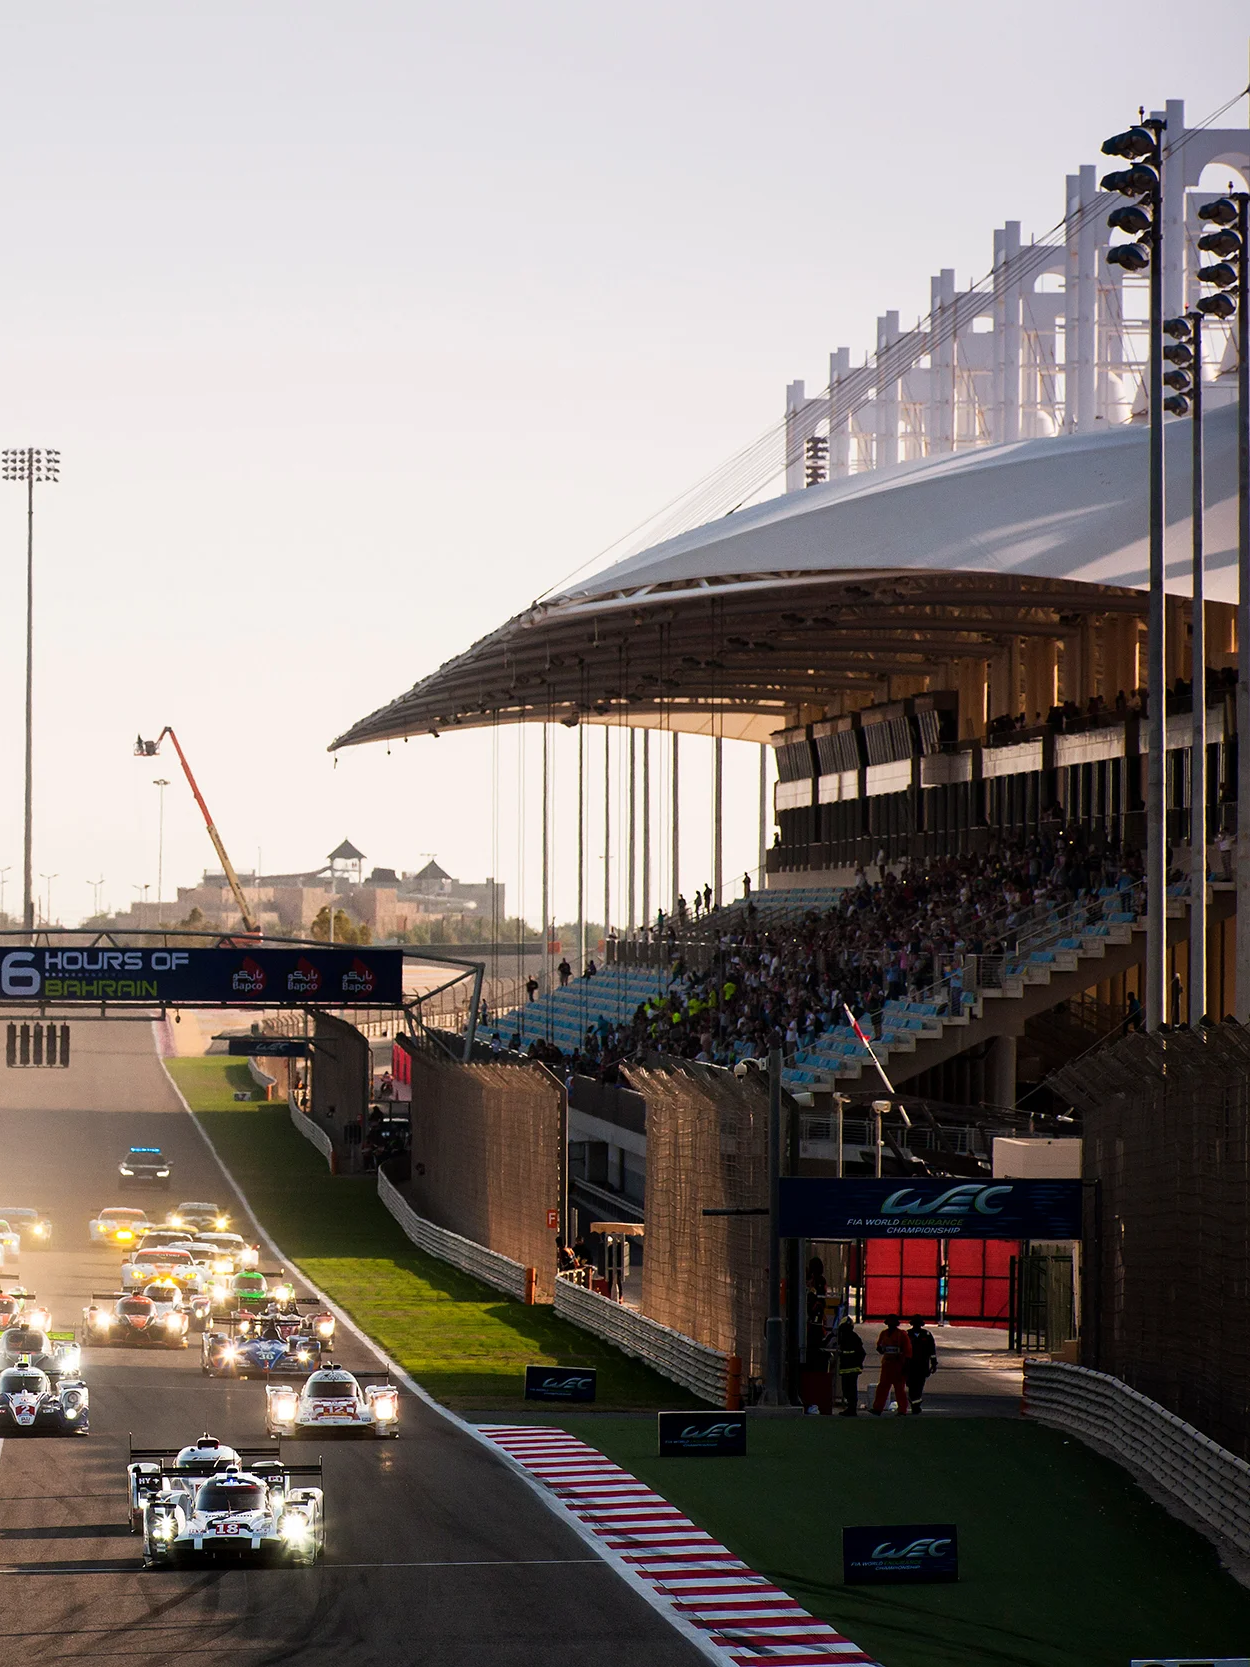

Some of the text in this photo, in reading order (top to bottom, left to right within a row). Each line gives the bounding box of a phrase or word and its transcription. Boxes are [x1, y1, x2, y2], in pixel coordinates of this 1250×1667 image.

[45, 952, 189, 971] HOURS OF
[1, 952, 41, 995] 6
[45, 980, 157, 997] BAHRAIN
[232, 981, 263, 992] Bapco
[287, 981, 318, 992] Bapco
[342, 982, 373, 992] Bapco
[881, 1184, 1013, 1214] WEC
[548, 1212, 556, 1225] F
[542, 1377, 592, 1390] WEC
[21, 1405, 30, 1413] 2
[680, 1423, 742, 1438] WEC
[216, 1524, 239, 1534] 18
[871, 1538, 952, 1558] WEC
